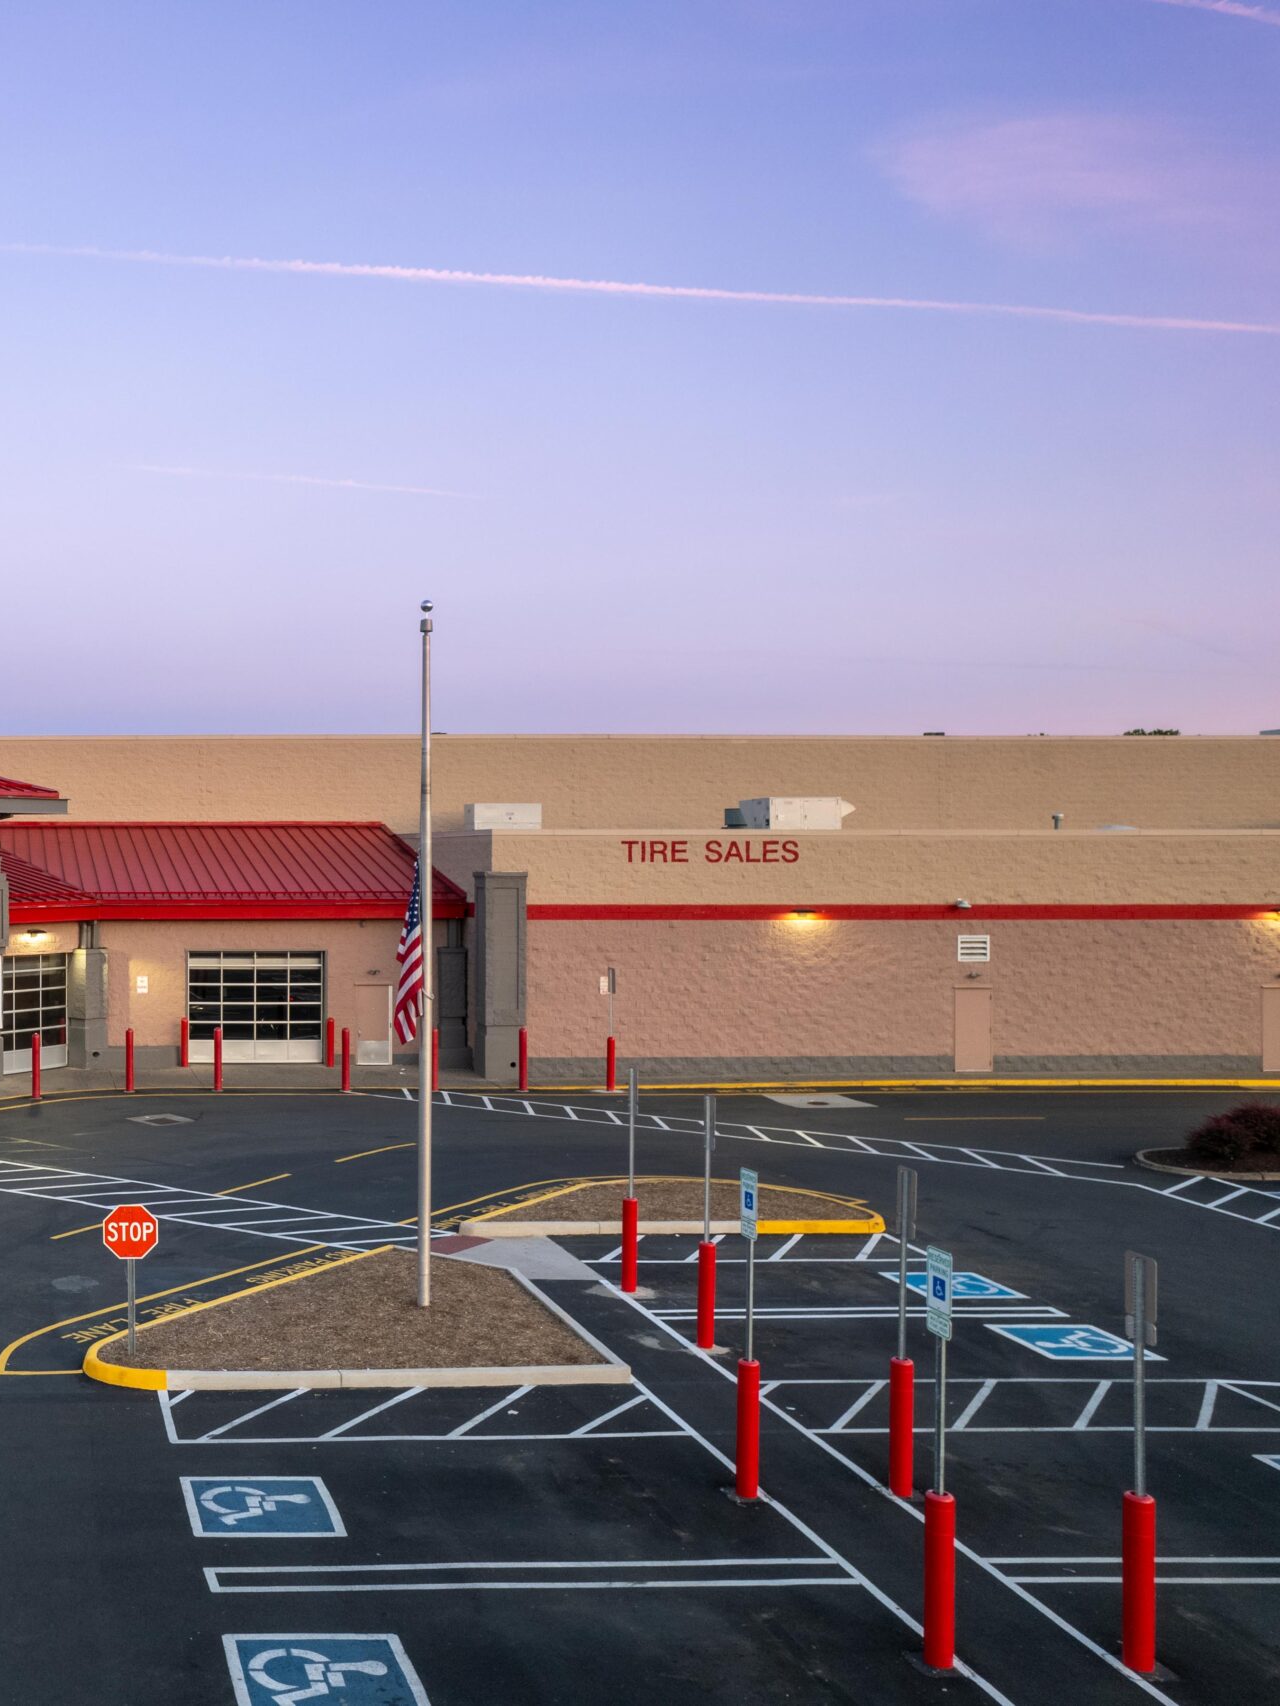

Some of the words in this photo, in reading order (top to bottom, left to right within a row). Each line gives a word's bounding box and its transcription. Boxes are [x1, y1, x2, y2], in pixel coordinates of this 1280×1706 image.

[621, 840, 689, 863] TIRE
[705, 840, 800, 863] SALES
[107, 1221, 155, 1242] STOP
[245, 1257, 328, 1285] PARKING
[140, 1297, 204, 1319] FIRE
